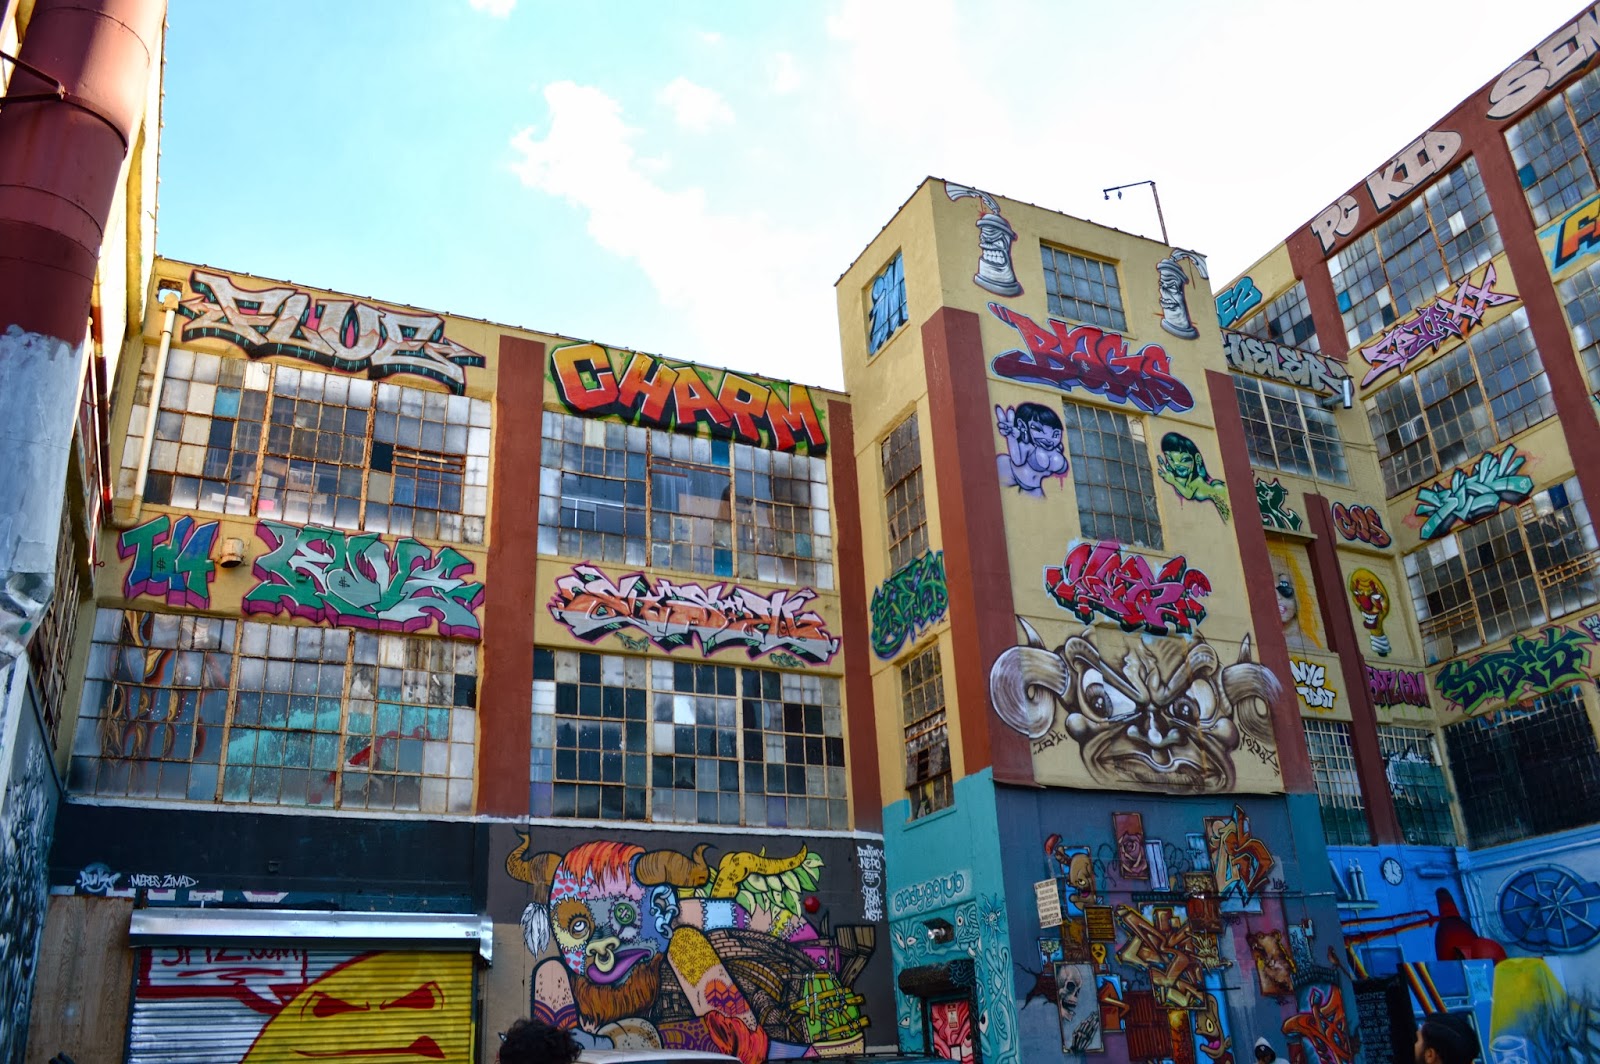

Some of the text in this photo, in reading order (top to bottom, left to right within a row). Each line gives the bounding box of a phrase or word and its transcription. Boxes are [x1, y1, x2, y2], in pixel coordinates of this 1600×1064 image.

[1366, 130, 1462, 213] KID
[549, 341, 829, 456] CHARM
[1289, 659, 1326, 688] NYC
